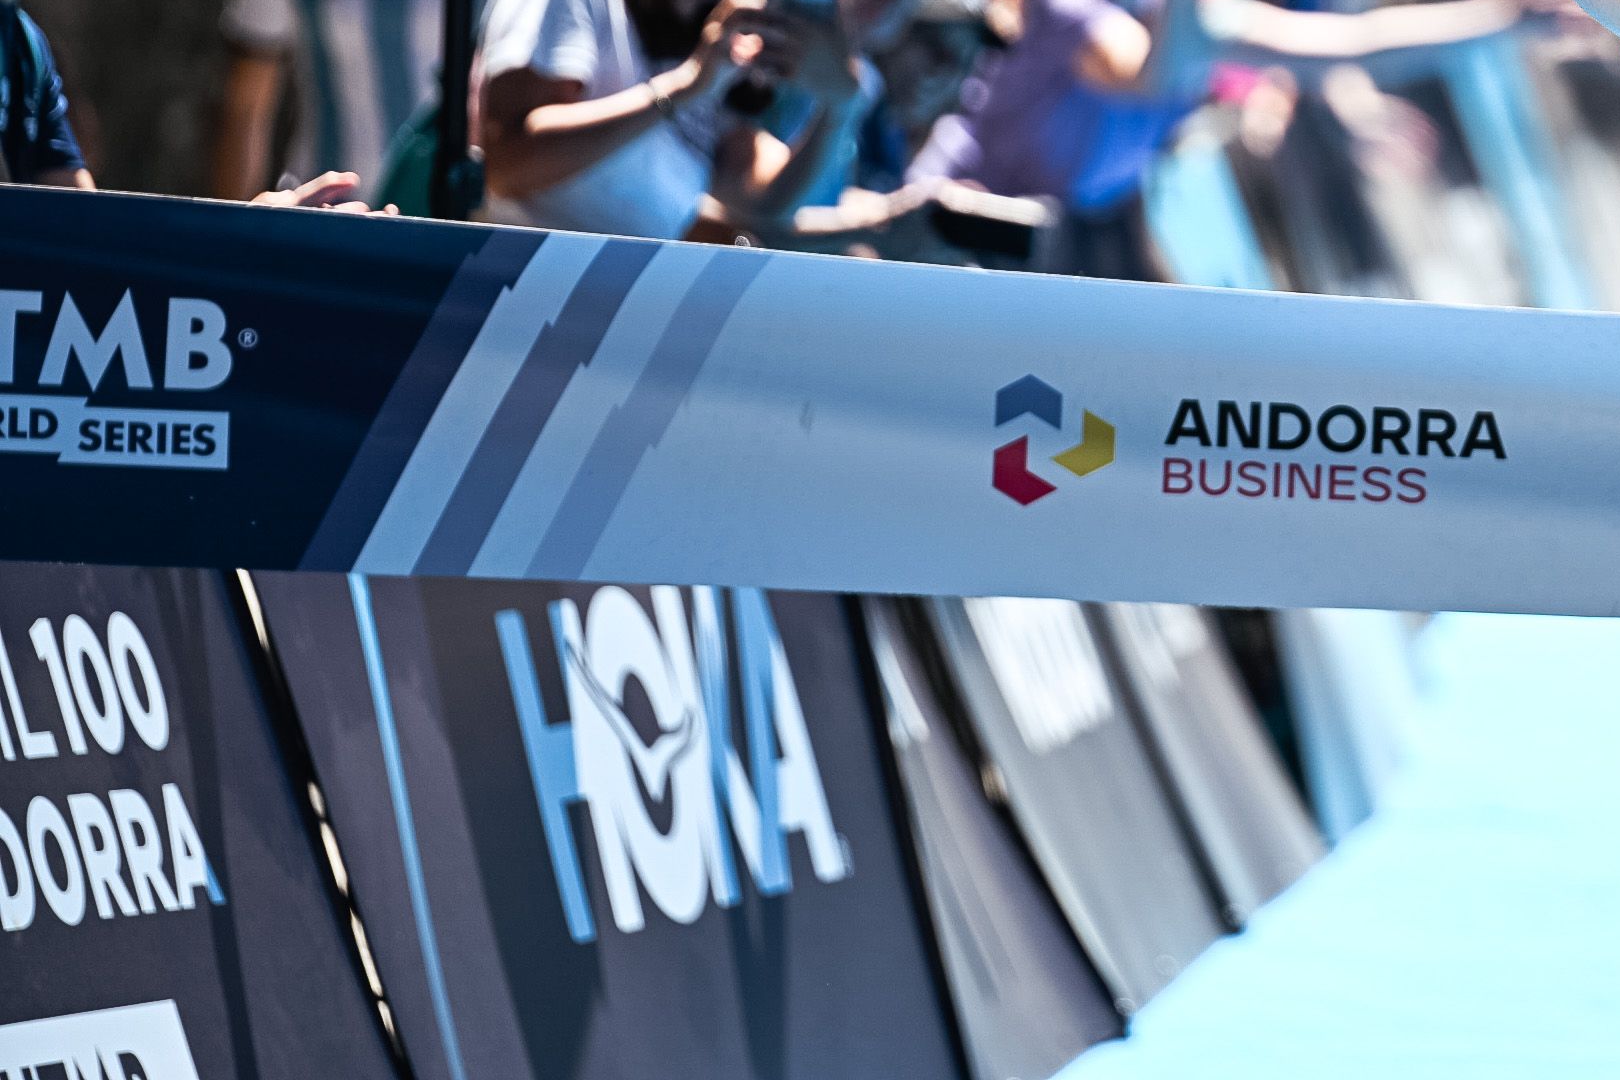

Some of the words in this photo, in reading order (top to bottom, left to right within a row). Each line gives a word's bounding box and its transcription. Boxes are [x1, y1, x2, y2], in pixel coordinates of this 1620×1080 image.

[0, 407, 59, 440] LD
[78, 419, 216, 456] SERIES
[1164, 398, 1507, 460] ANDORRA
[1161, 457, 1427, 504] BUSINESS
[28, 610, 170, 757] 100
[494, 584, 848, 944] HOKA
